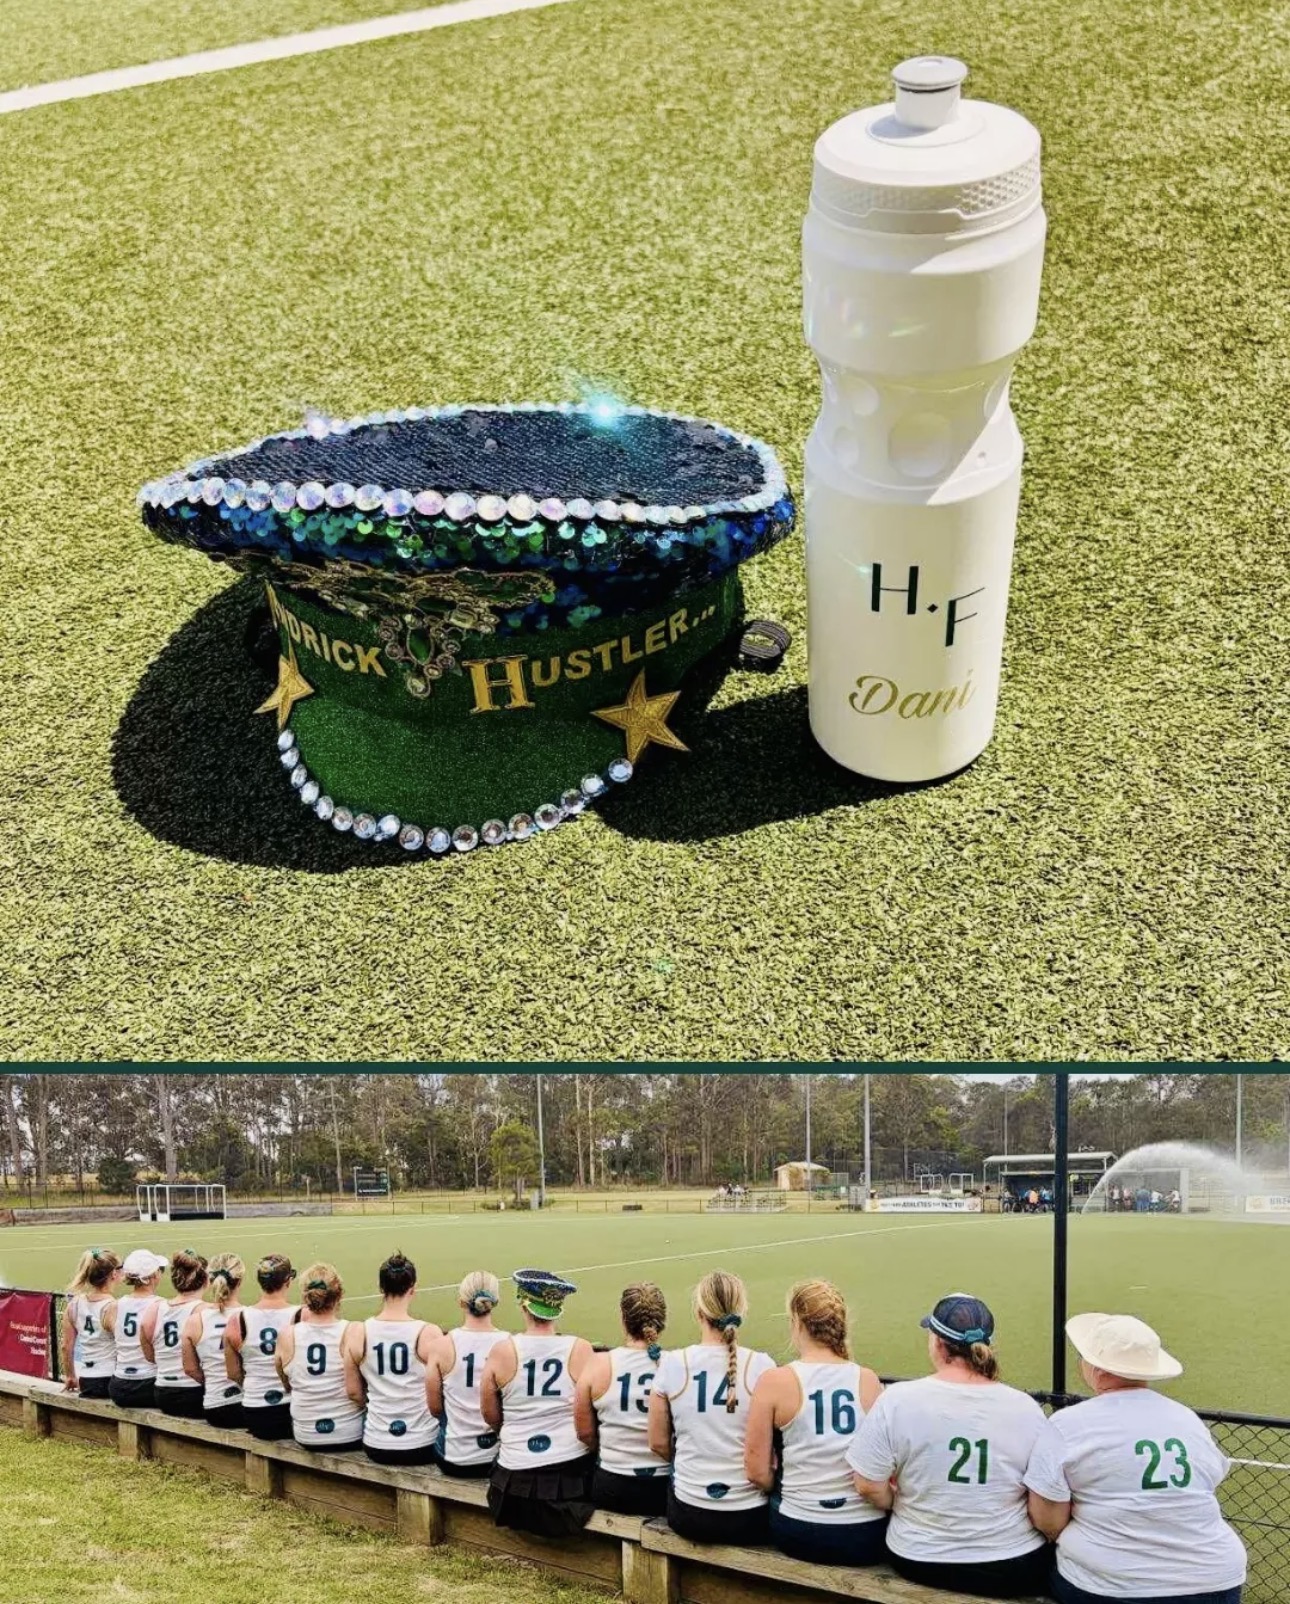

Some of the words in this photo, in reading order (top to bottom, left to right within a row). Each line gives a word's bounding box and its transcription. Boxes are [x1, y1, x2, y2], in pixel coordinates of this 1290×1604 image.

[848, 668, 976, 719] Dani
[83, 1315, 95, 1336] 4
[123, 1312, 138, 1337] 5
[163, 1321, 179, 1347] 6
[259, 1327, 278, 1356] 8
[307, 1343, 326, 1376] 9
[372, 1342, 410, 1376] 10
[523, 1358, 564, 1397] 12
[616, 1372, 655, 1412] 13
[693, 1370, 739, 1413] 14
[808, 1389, 856, 1435] 16
[947, 1437, 989, 1485] 21
[1134, 1437, 1192, 1490] 23
